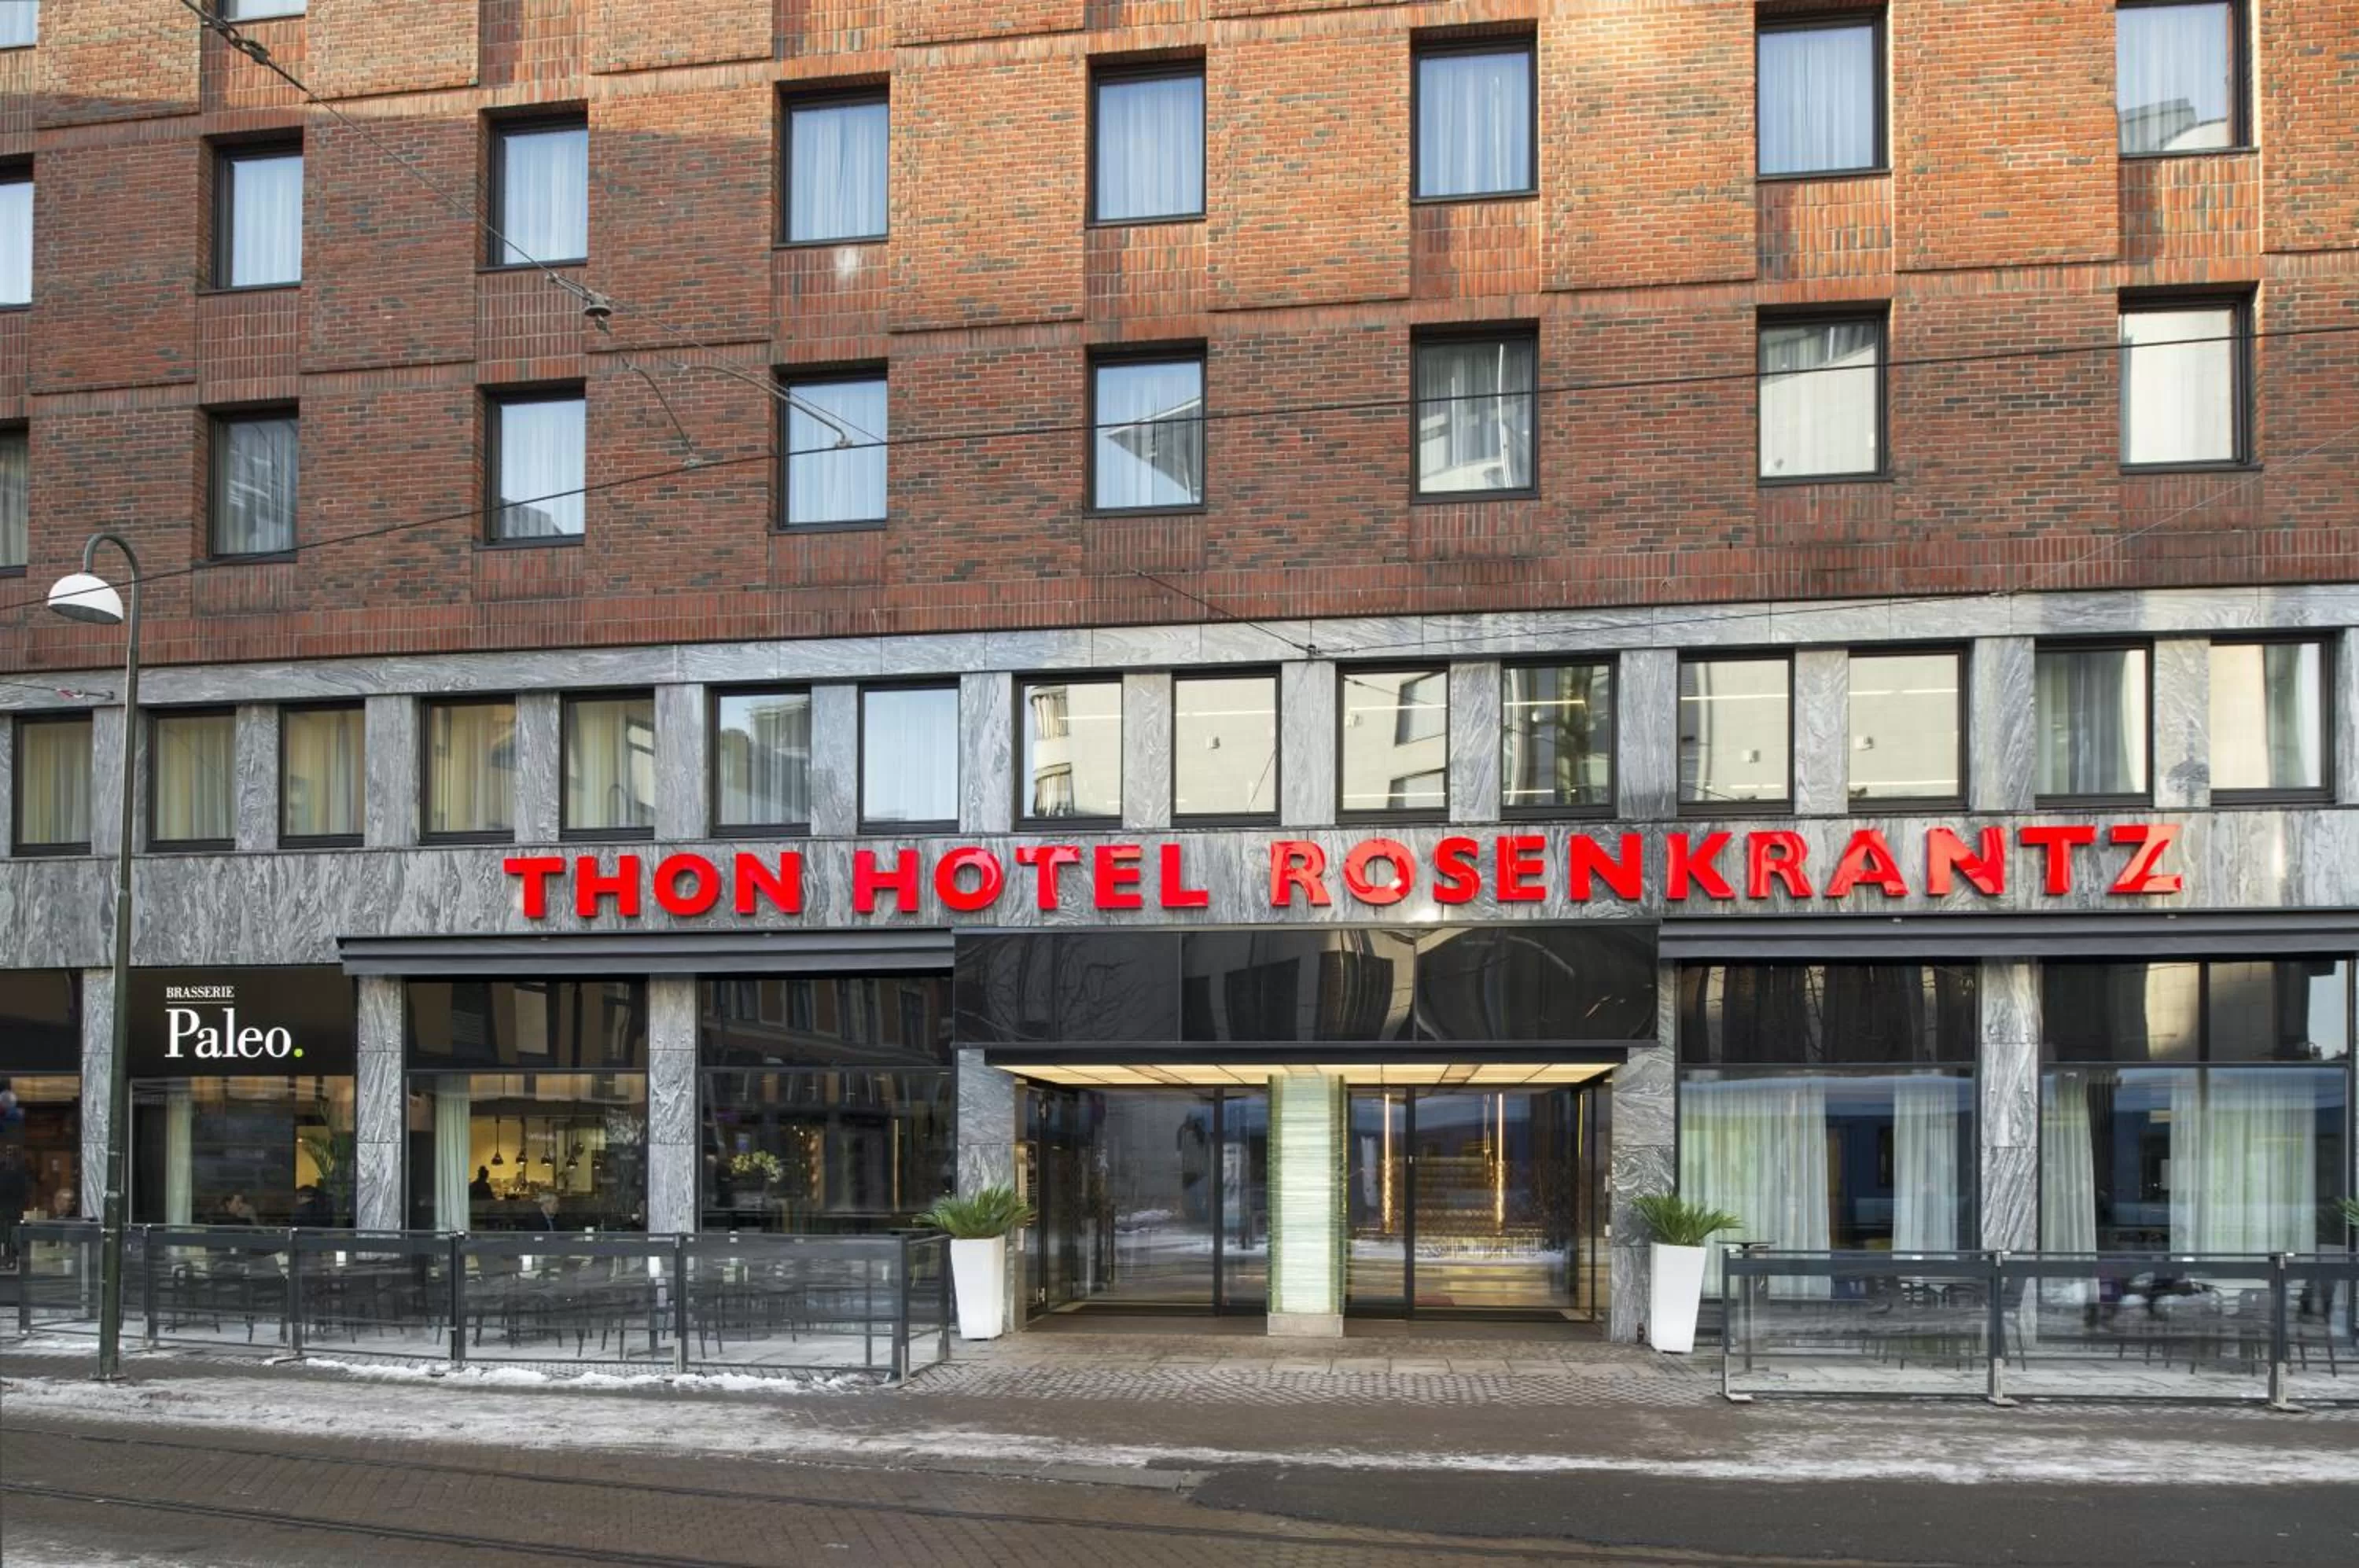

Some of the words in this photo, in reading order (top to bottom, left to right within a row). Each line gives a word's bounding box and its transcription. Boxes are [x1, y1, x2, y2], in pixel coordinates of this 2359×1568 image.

[502, 850, 802, 918] THON
[853, 842, 1209, 912] HOTEL
[1270, 823, 2183, 906] ROSENKRANTZ
[166, 985, 235, 998] BRASSERIE
